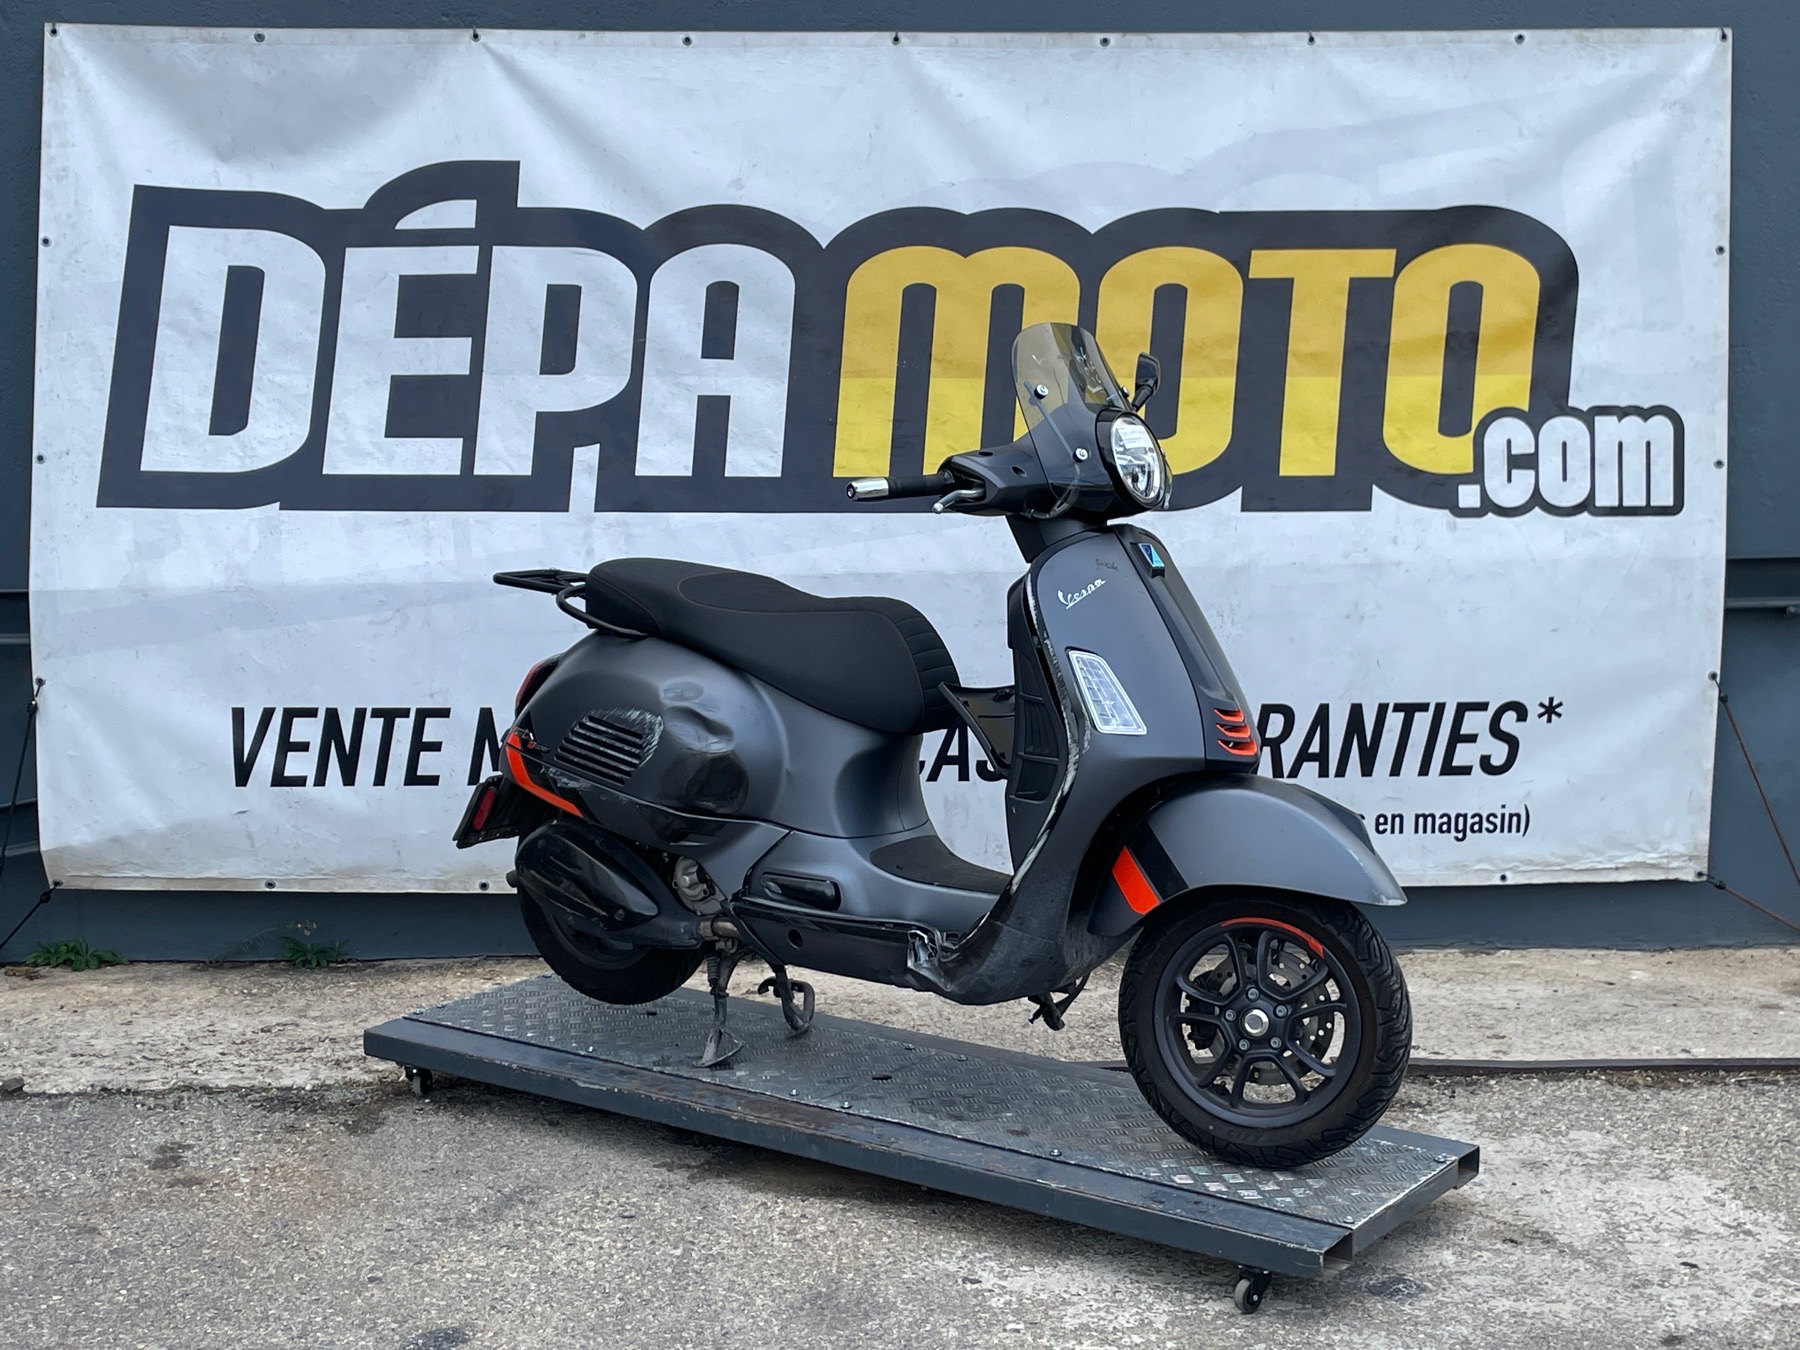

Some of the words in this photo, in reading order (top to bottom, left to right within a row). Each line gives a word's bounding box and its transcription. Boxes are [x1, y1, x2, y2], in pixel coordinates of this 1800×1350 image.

[232, 707, 451, 787] VENTE
[1257, 697, 1563, 779] RANTIES
[1375, 812, 1404, 835] en
[1414, 804, 1530, 842] magasin)
